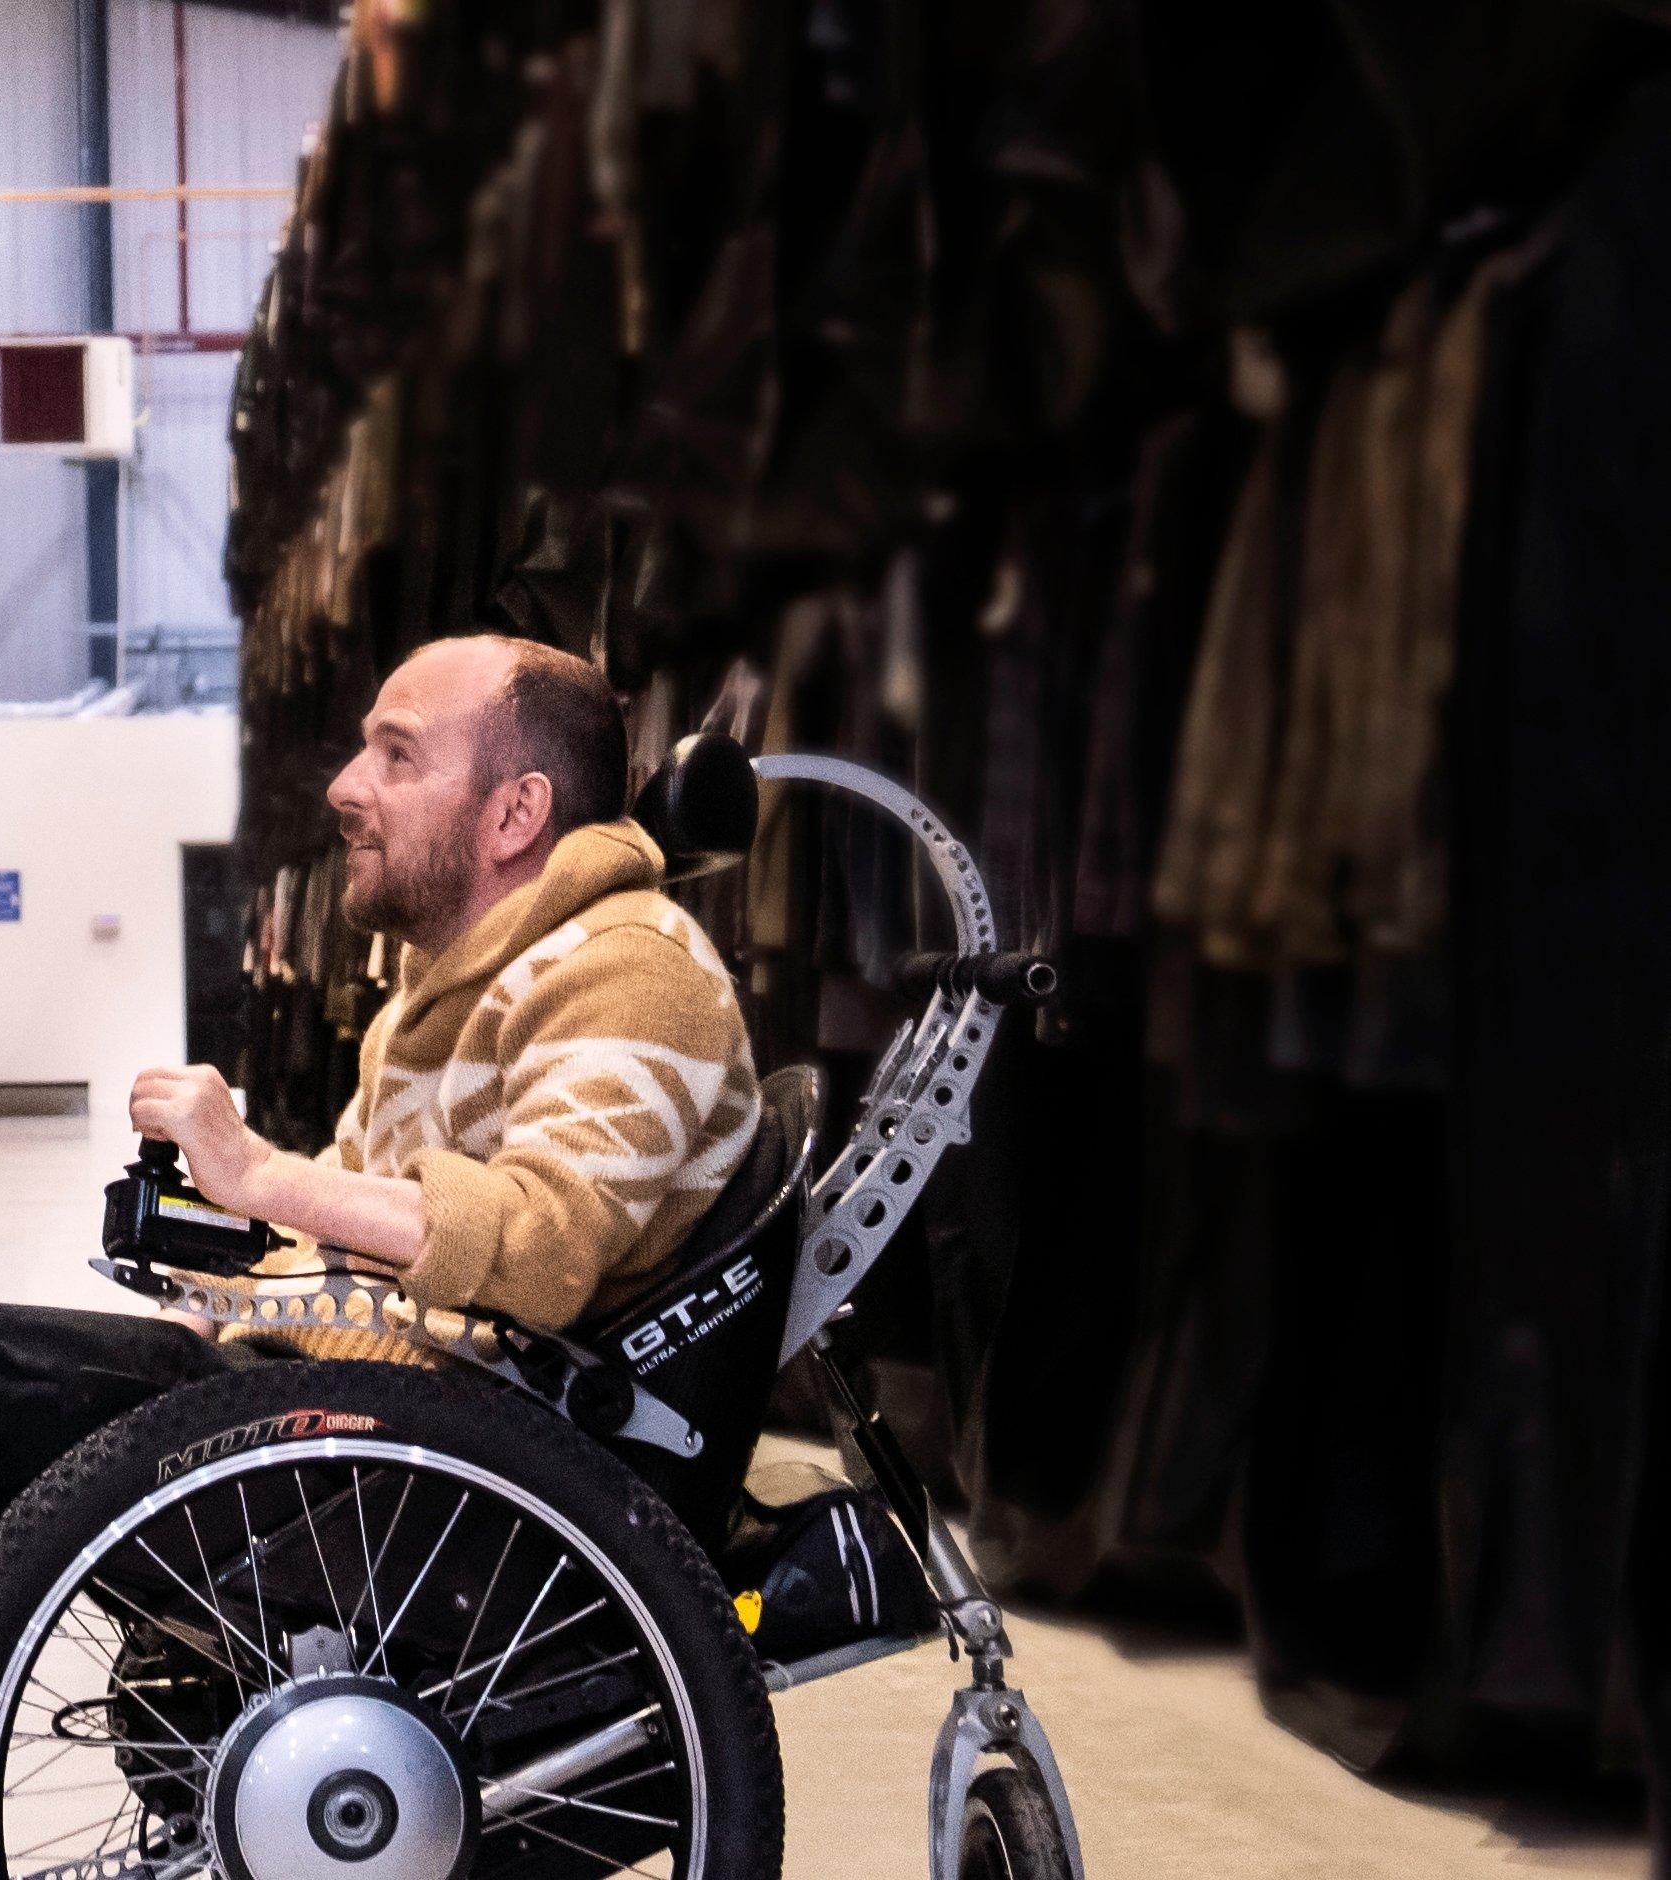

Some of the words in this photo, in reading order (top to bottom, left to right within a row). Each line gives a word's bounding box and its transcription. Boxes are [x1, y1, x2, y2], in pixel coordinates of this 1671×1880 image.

[621, 1254, 760, 1361] GT-E
[636, 1345, 678, 1376] ULTRA
[686, 1280, 764, 1343] LIGHTWEIGHT
[157, 1409, 325, 1485] MOTO
[326, 1413, 376, 1432] DIGGER
